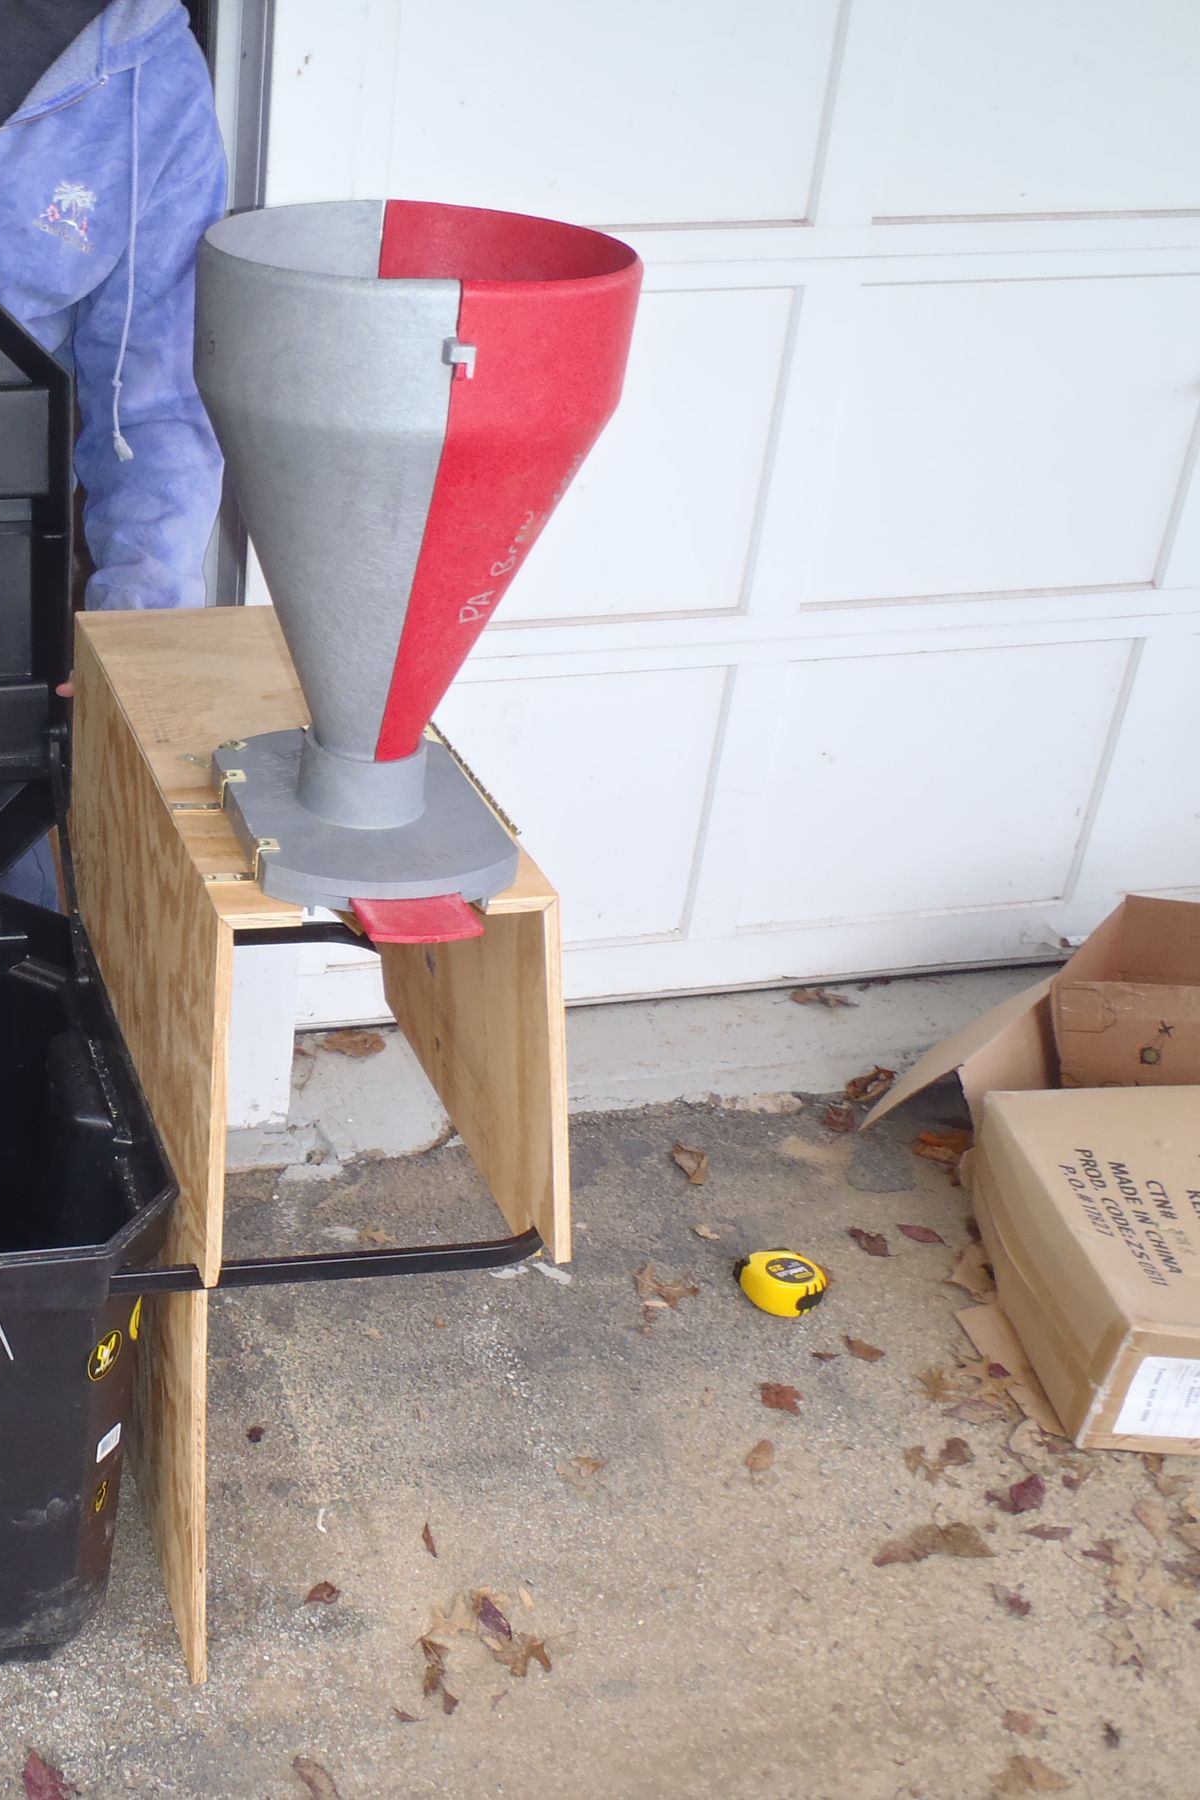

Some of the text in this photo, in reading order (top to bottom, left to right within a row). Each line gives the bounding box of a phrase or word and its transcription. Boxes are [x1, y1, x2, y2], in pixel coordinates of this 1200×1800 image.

[459, 590, 494, 624] PA
[1074, 1148, 1107, 1191] PROD.
[1107, 1161, 1144, 1205] MADE
[1132, 1209, 1154, 1225] IN
[1145, 1230, 1183, 1274] CHINA
[1145, 1180, 1178, 1220] CTN#
